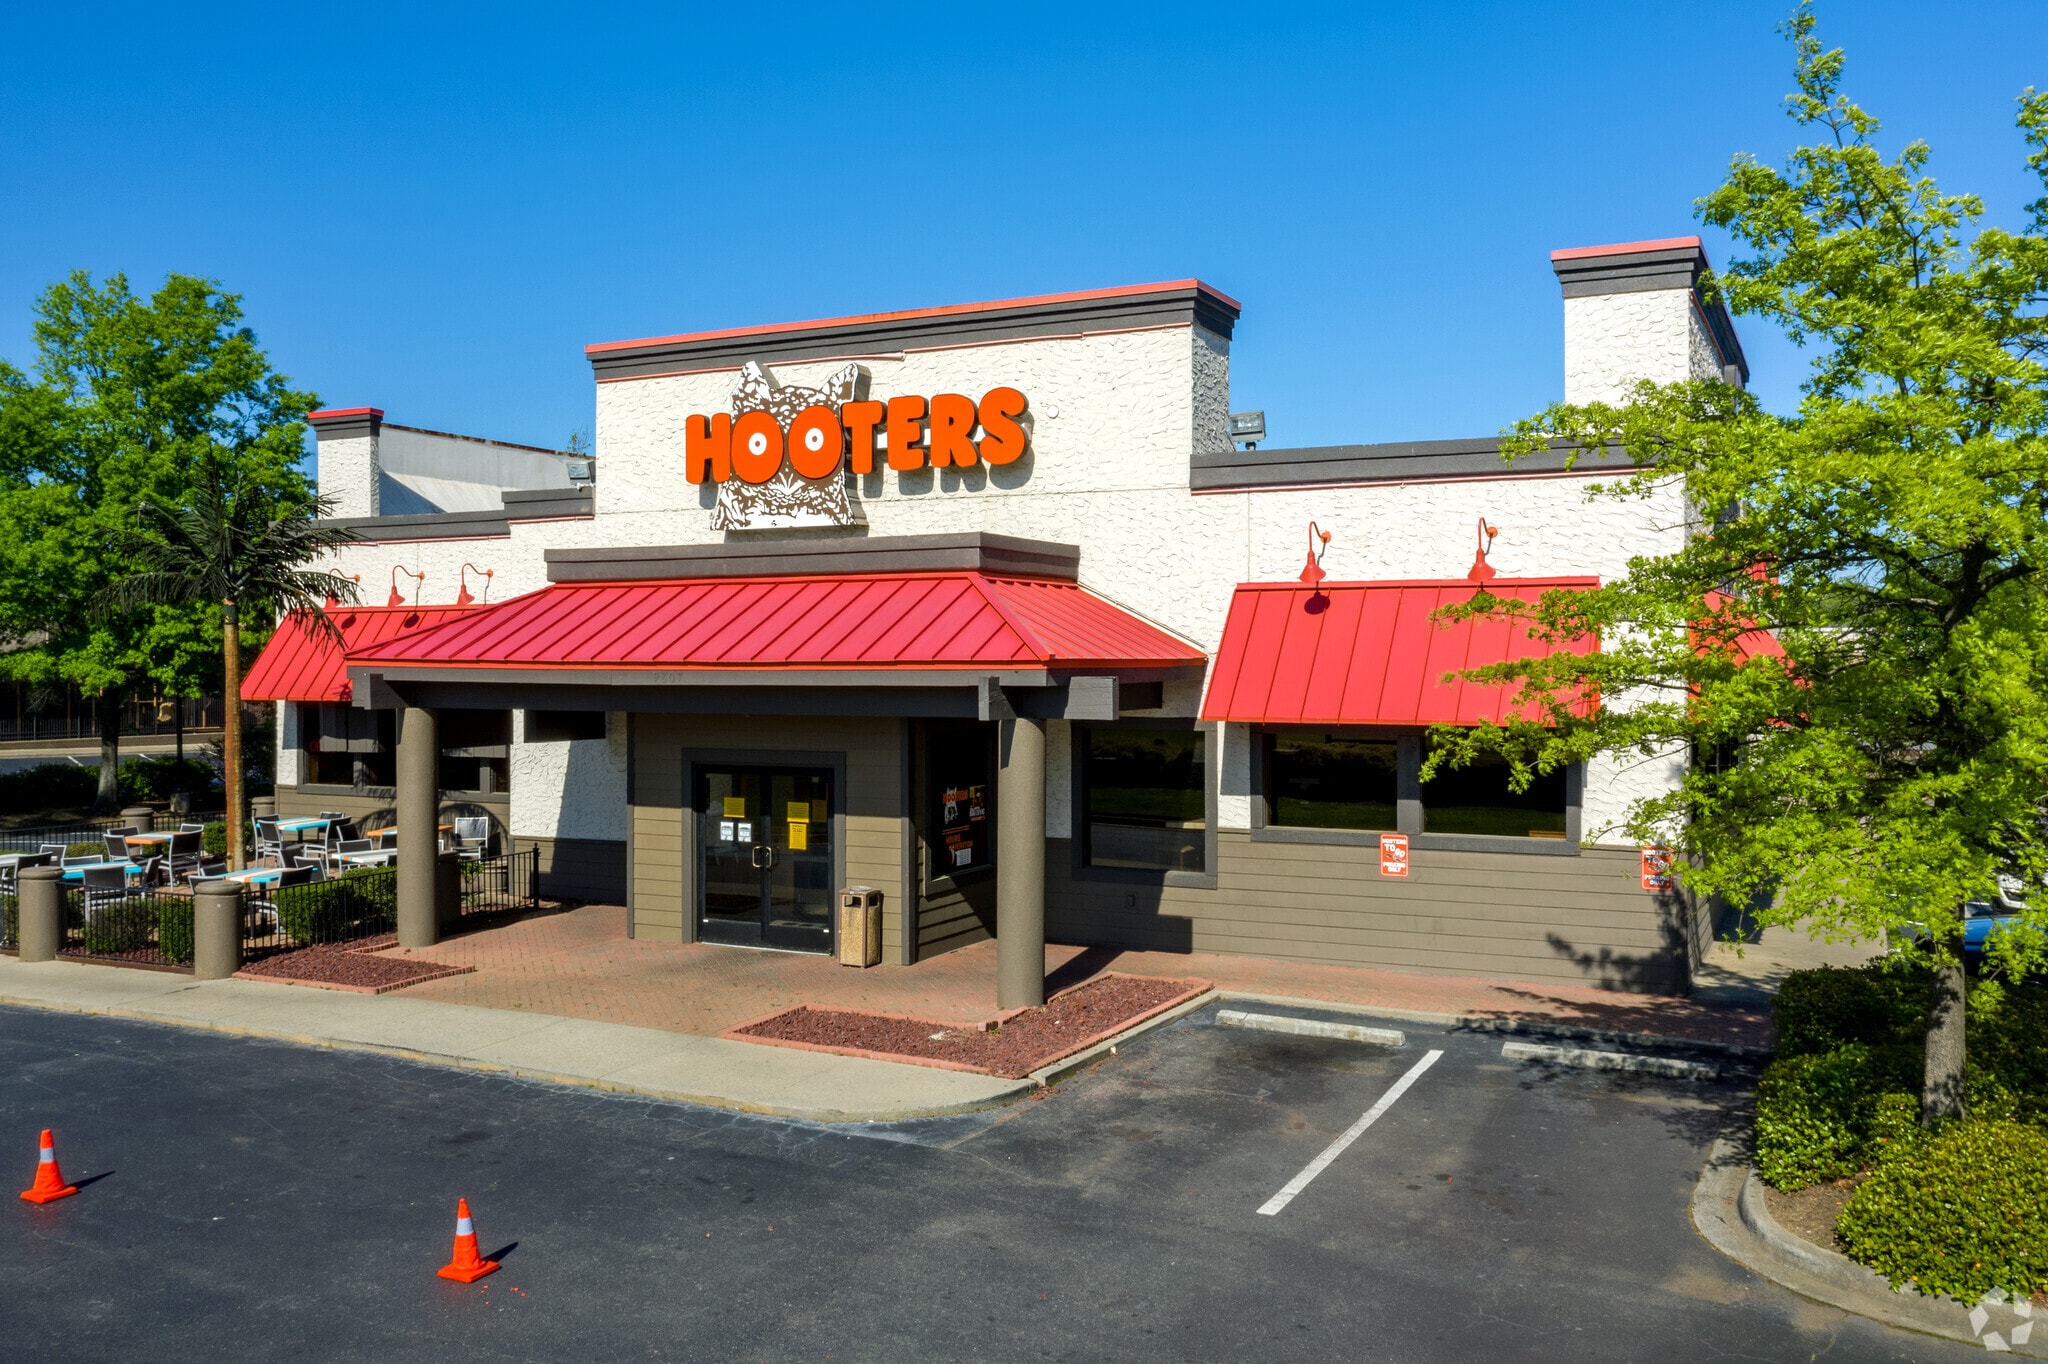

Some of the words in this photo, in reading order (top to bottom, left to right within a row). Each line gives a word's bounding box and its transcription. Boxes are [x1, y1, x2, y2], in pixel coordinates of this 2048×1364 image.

[685, 387, 1030, 485] HOOTERS
[1384, 843, 1396, 852] TO
[1395, 848, 1406, 858] GO
